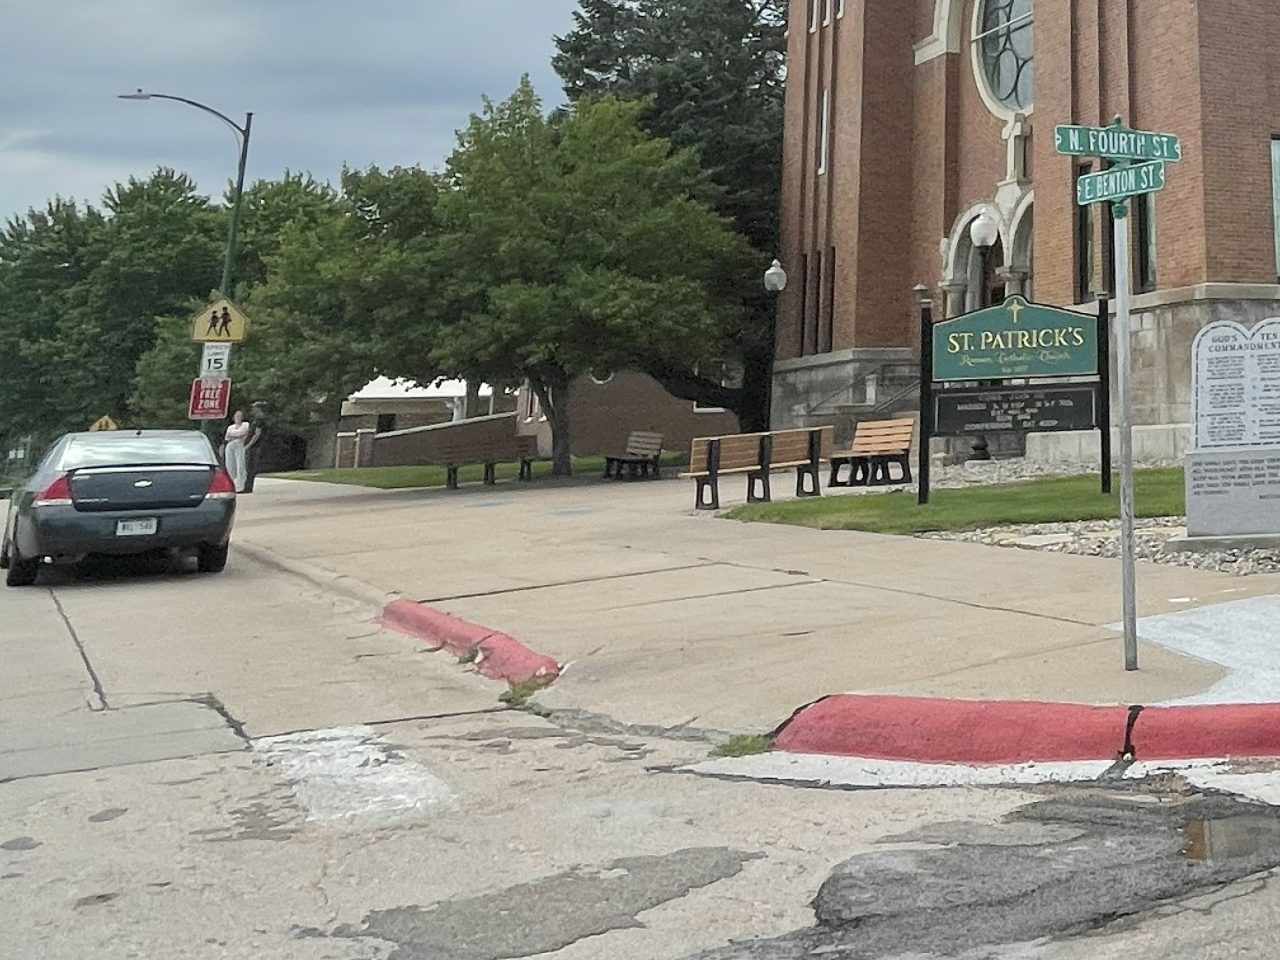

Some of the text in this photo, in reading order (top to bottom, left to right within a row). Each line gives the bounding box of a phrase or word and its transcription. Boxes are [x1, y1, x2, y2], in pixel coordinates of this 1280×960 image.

[1069, 129, 1168, 157] N. FOURTH ST
[1096, 168, 1136, 197] BENTON
[1141, 165, 1154, 188] ST
[947, 326, 1085, 353] ST. PATRICK'S
[1260, 332, 1278, 341] TEN
[207, 357, 224, 370] 15
[200, 388, 221, 399] FREE
[198, 399, 220, 409] ZONE
